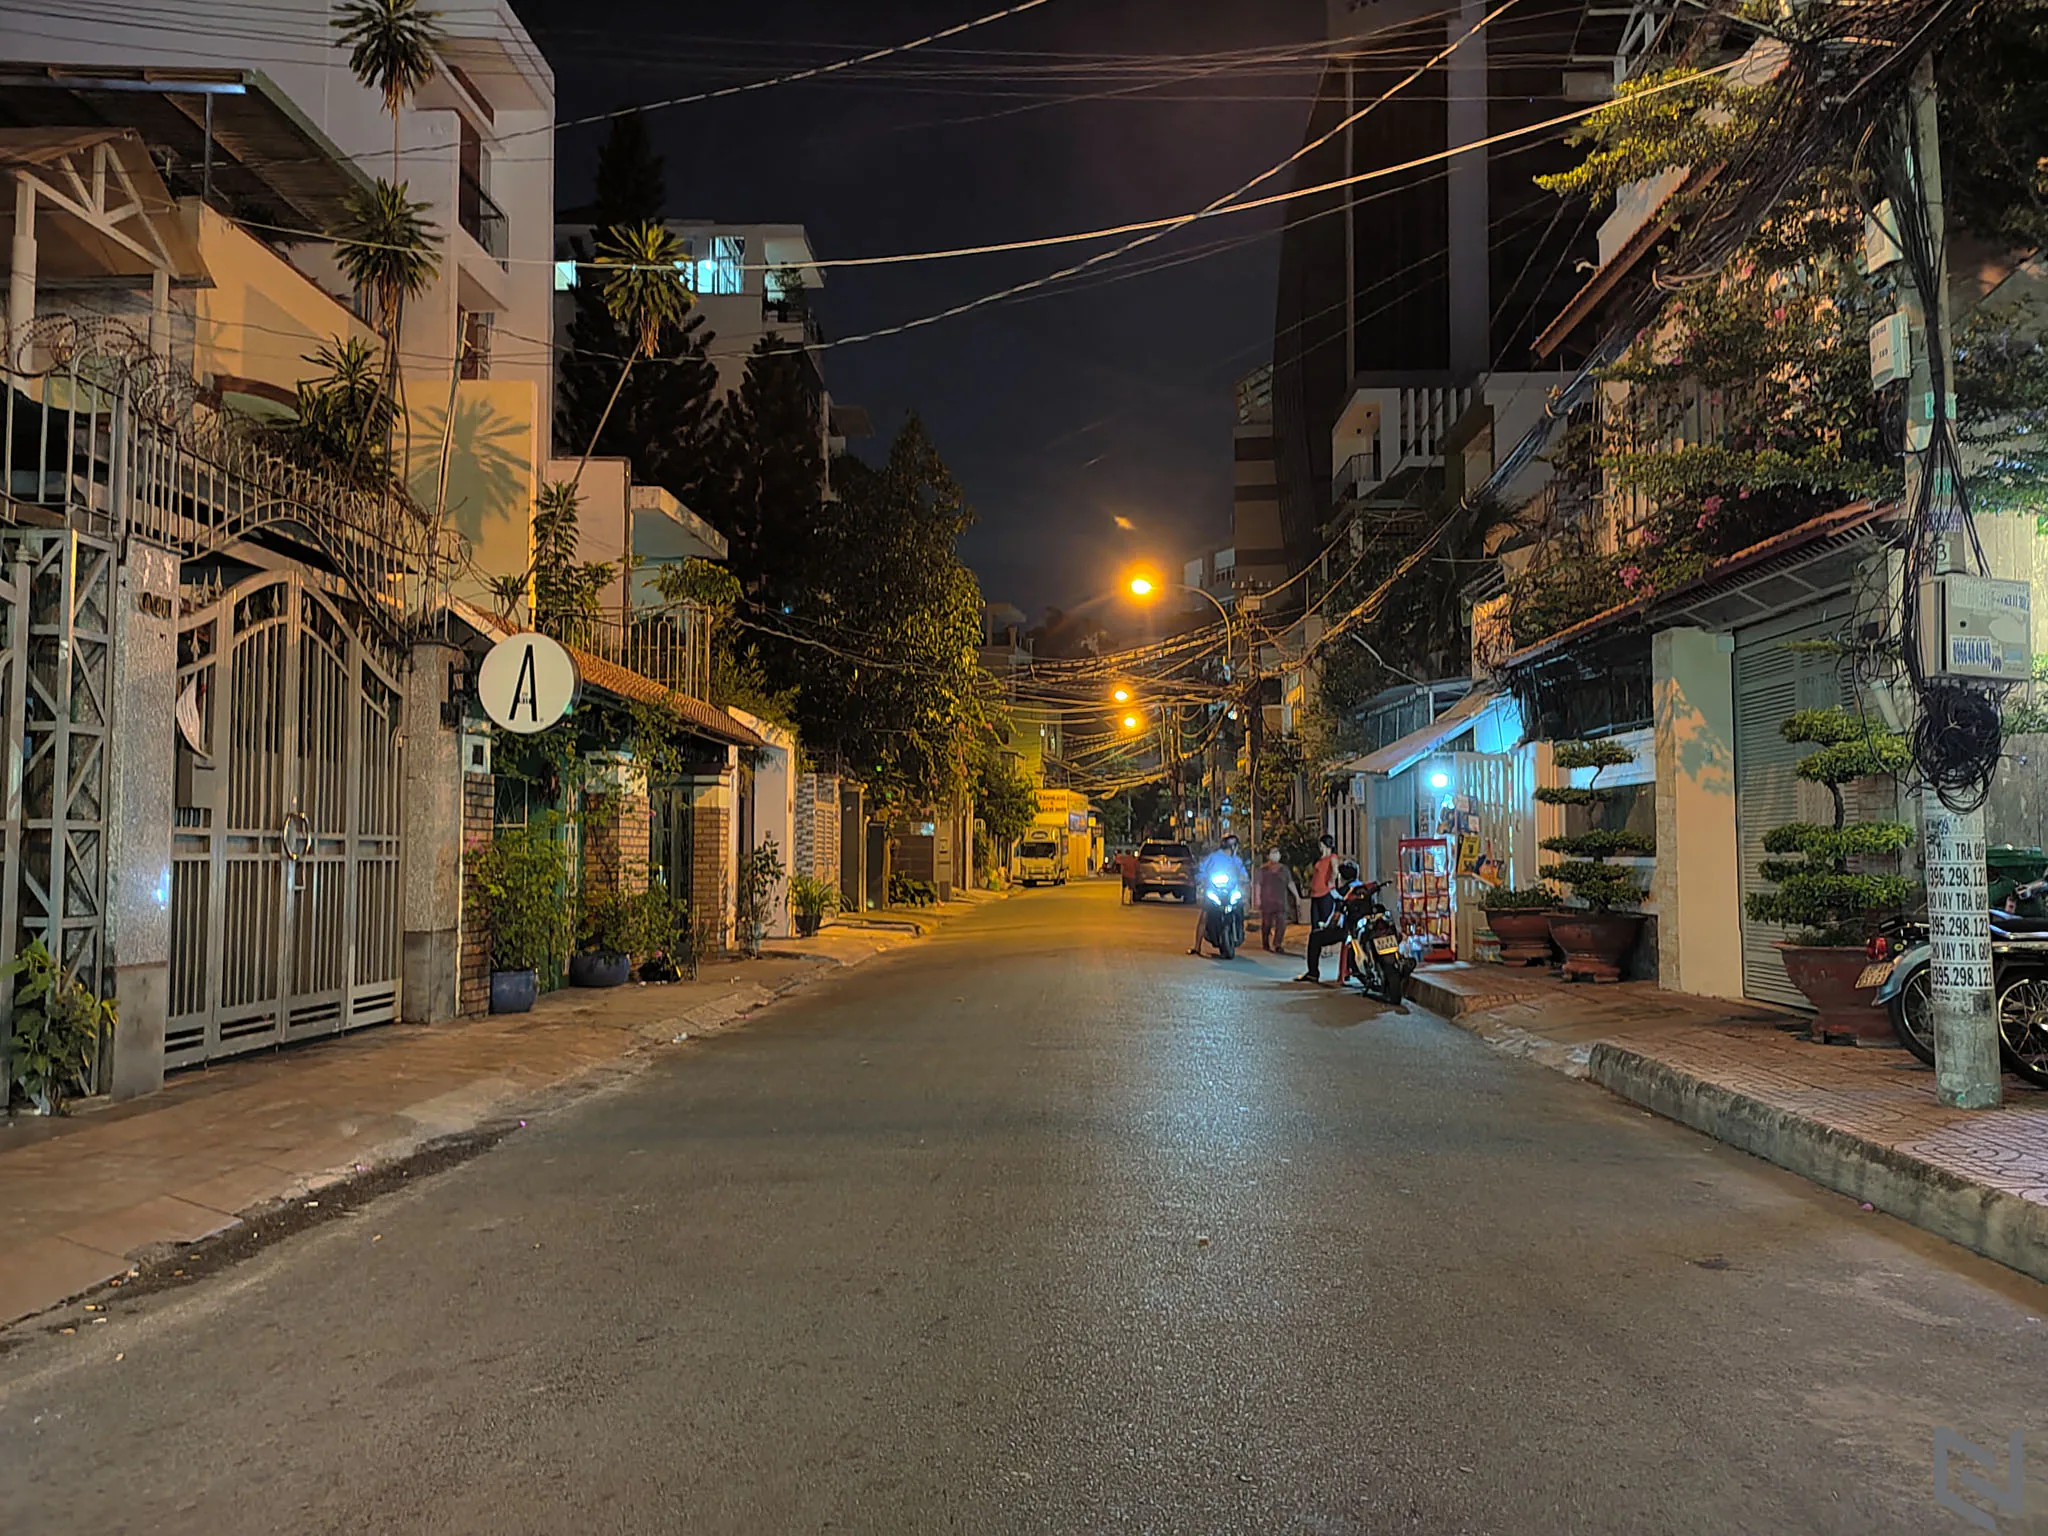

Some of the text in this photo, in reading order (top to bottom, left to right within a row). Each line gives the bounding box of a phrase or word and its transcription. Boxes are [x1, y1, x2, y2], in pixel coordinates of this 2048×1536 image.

[508, 644, 538, 722] A
[1938, 891, 1953, 909] VAY
[1941, 941, 1956, 960] VAY
